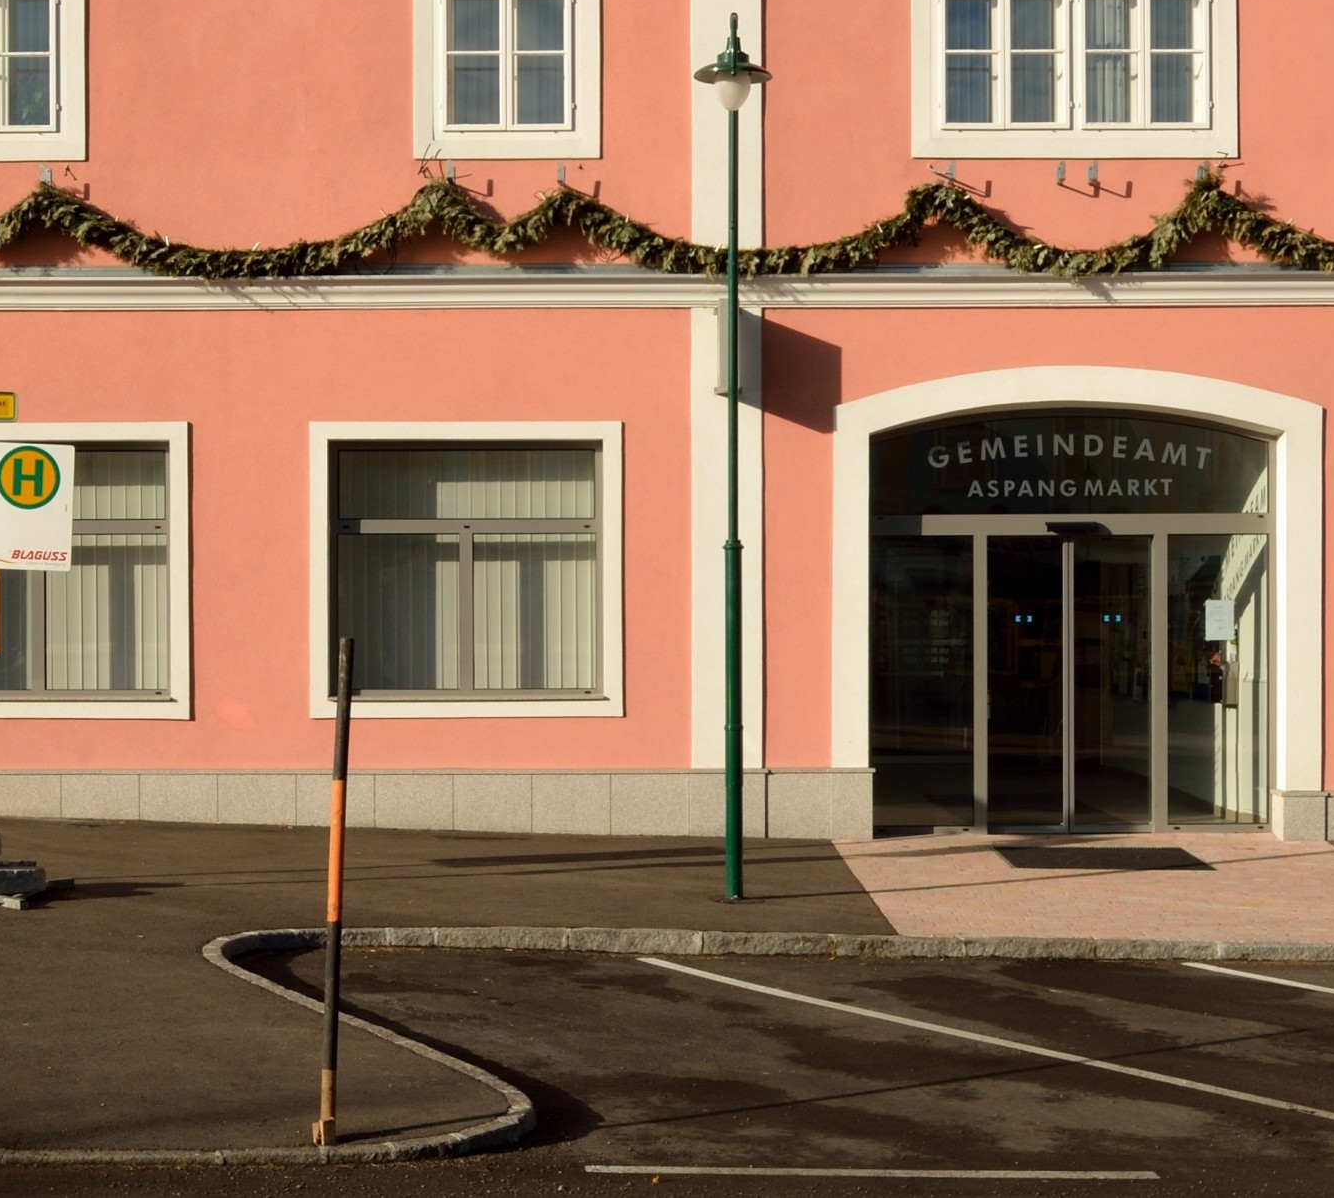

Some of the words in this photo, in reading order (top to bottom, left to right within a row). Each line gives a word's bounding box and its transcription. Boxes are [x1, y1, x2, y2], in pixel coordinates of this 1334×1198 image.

[927, 433, 1212, 470] GEMEINDEAMT
[12, 458, 44, 497] H
[967, 479, 1077, 498] ASPANG
[1083, 478, 1173, 497] MARKT
[11, 549, 68, 562] BLAGUSS
